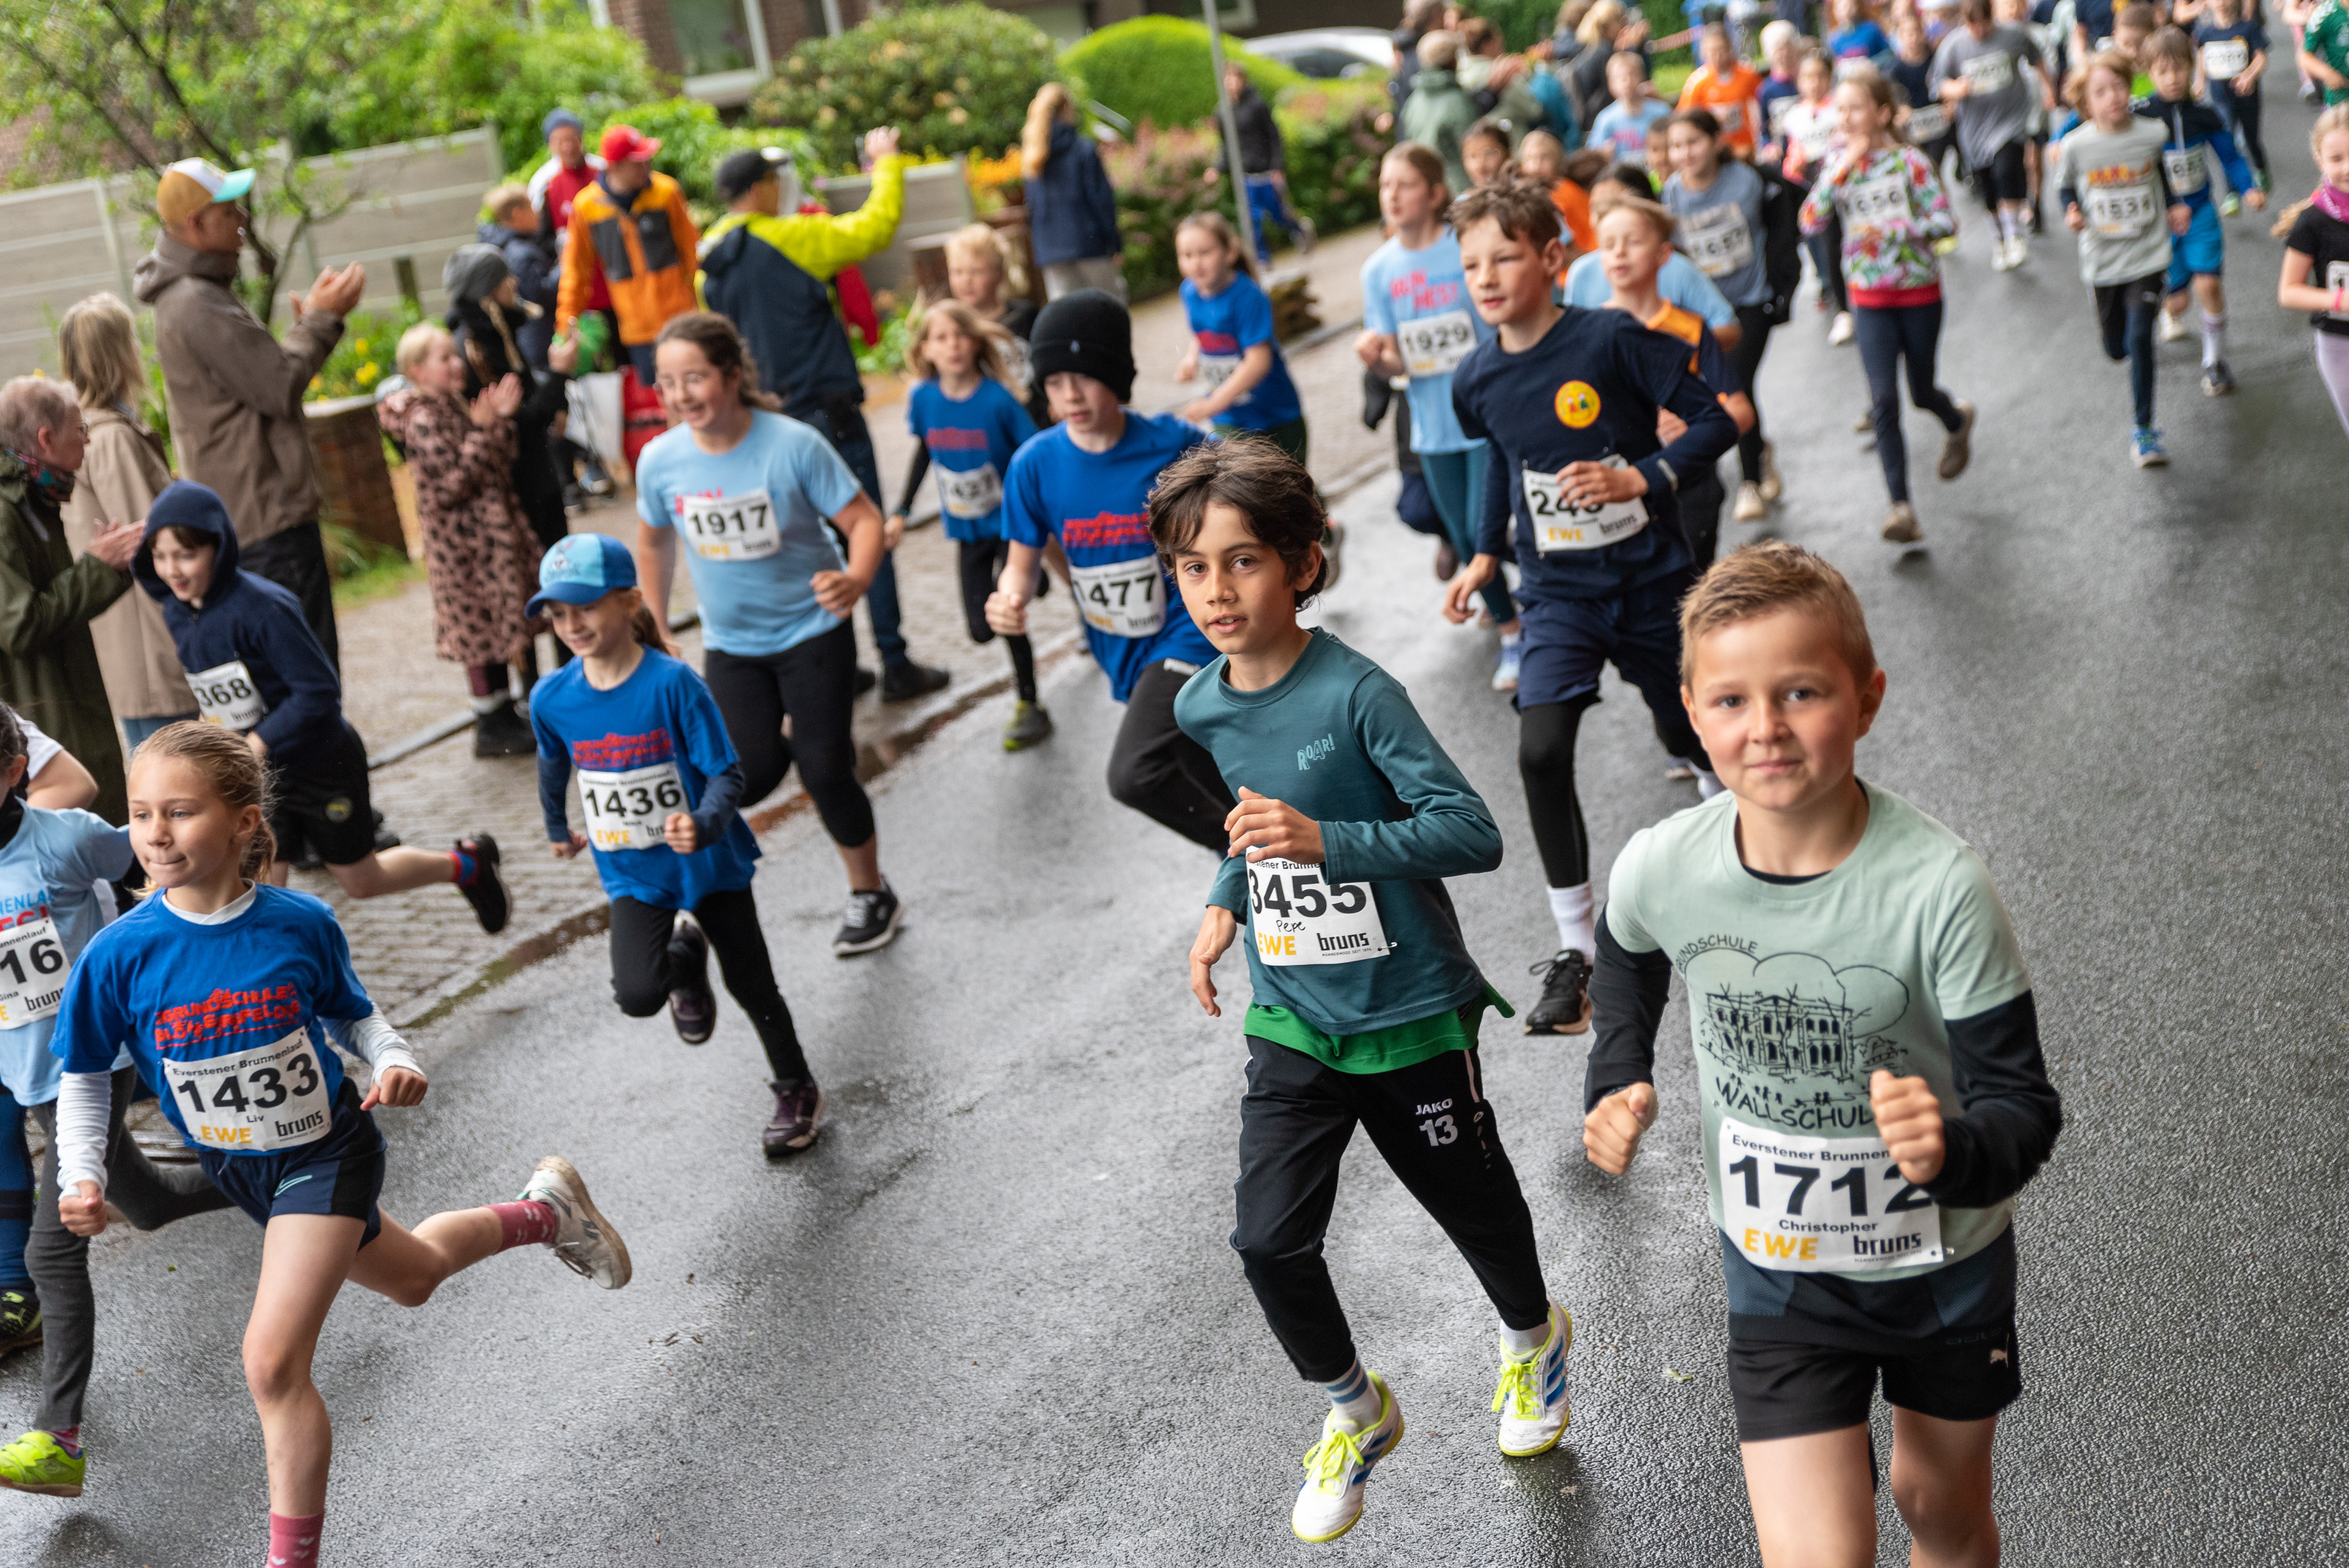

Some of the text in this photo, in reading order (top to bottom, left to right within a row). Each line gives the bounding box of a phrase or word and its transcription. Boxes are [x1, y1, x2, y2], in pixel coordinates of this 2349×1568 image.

[1405, 322, 1468, 352] 1929
[690, 503, 767, 535] 1917
[1548, 527, 1584, 542] EWE
[1297, 733, 1336, 771] ROAR!
[585, 779, 681, 817] 1436
[596, 829, 631, 844] EWE
[1249, 868, 1367, 918] 3455
[1276, 919, 1306, 933] Pepe
[1258, 932, 1370, 956] EWE bruns
[173, 1039, 304, 1077] Everstener Brunnenlauf
[177, 1053, 319, 1113] 1433
[246, 1114, 264, 1123] Liv
[1415, 1098, 1453, 1115] JAKO
[1716, 1076, 1875, 1130] WALLSCHUL
[200, 1125, 253, 1144] EWE
[275, 1110, 324, 1137] bruns
[1419, 1114, 1458, 1147] 13
[1733, 1134, 1890, 1161] Everstener Brunnen
[1729, 1155, 1932, 1217] 1712
[1779, 1219, 1879, 1234] Christopher
[1744, 1227, 1922, 1261] EWE bruns
